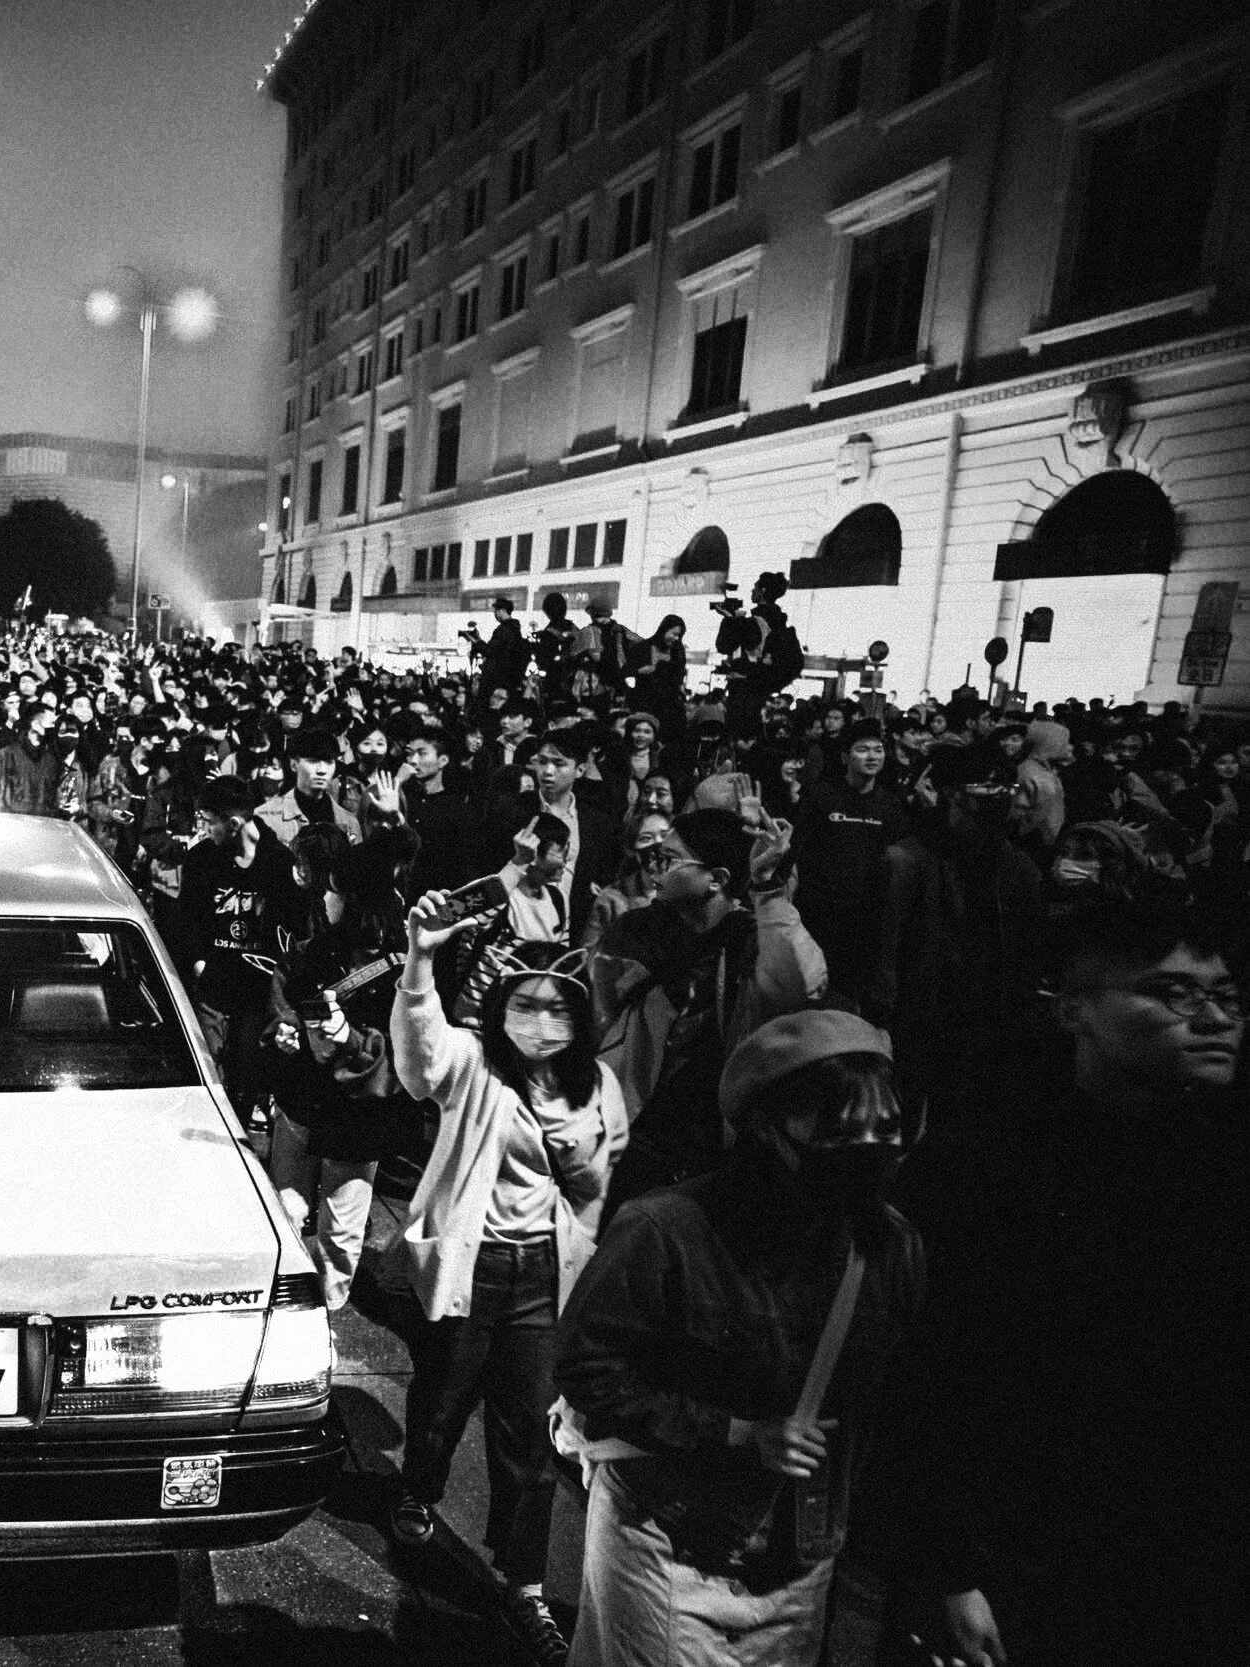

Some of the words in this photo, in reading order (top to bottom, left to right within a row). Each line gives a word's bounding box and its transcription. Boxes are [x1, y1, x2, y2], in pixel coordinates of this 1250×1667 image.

[215, 939, 229, 948] LOS
[110, 1294, 158, 1311] LPG
[162, 1289, 265, 1308] COMFORT
